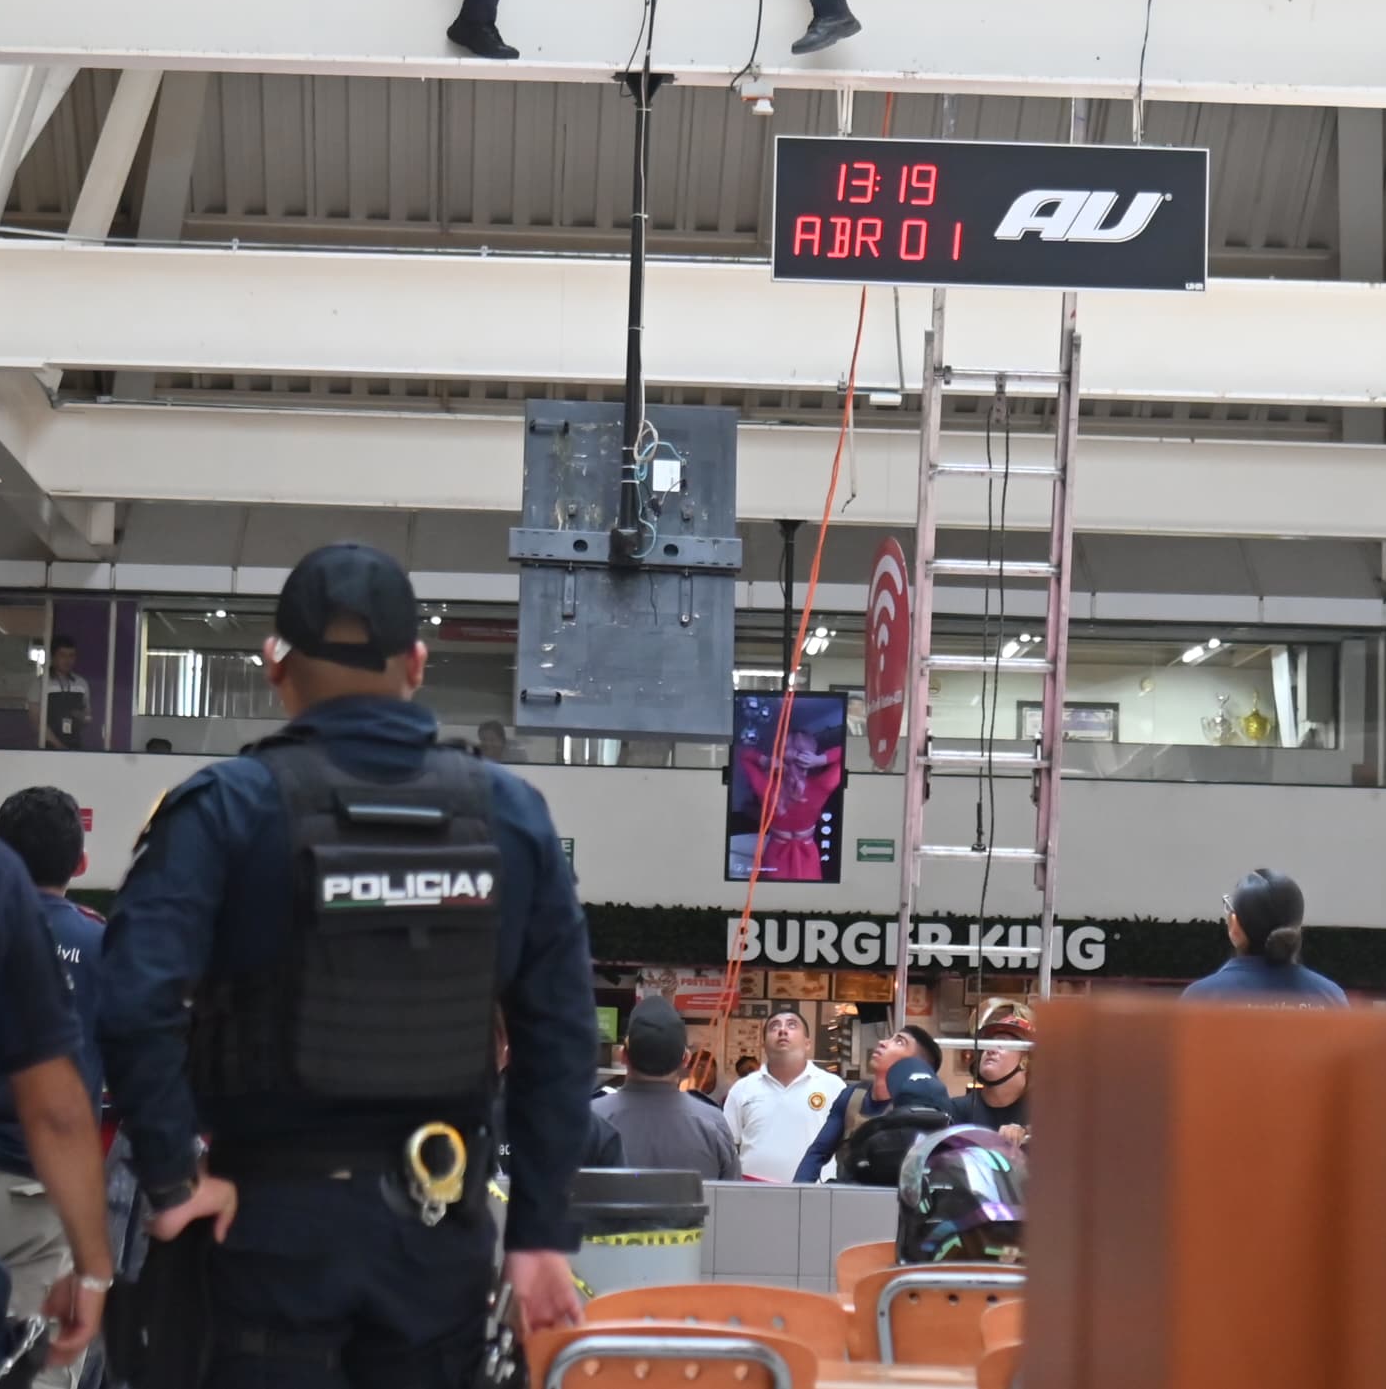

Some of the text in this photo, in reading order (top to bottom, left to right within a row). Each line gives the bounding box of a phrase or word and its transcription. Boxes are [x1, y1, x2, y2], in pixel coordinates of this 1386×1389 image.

[837, 162, 938, 206] 13:19
[792, 215, 883, 259] ABR
[993, 189, 1164, 243] AU
[323, 871, 477, 902] POLICIA
[727, 917, 1107, 972] BURGER KING
